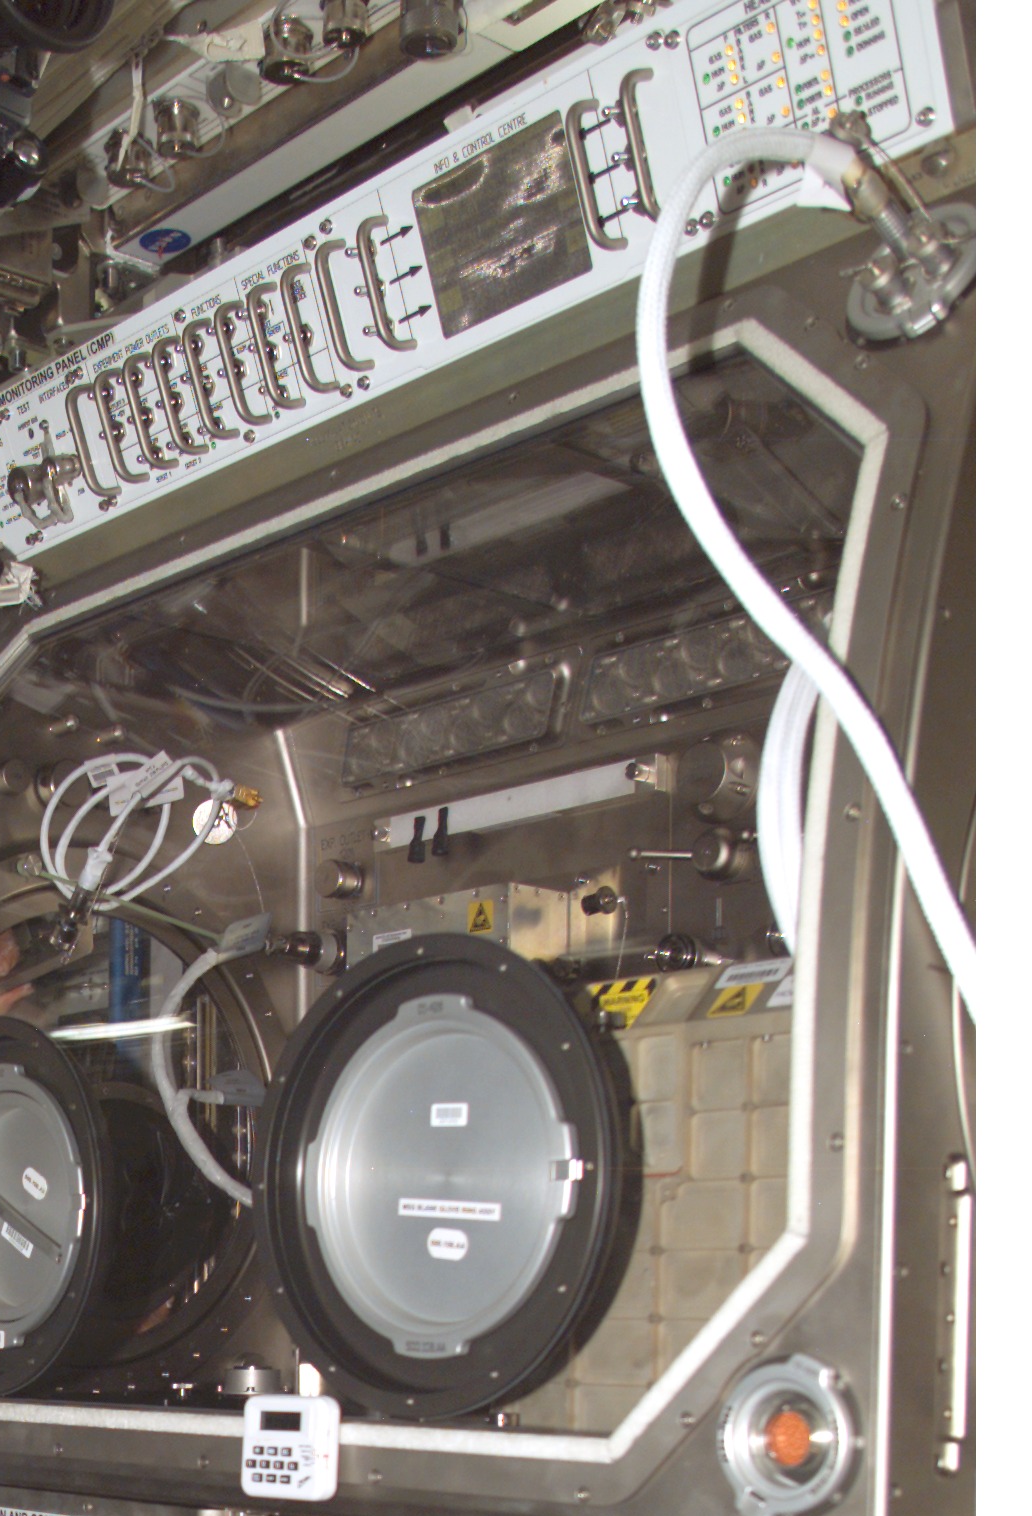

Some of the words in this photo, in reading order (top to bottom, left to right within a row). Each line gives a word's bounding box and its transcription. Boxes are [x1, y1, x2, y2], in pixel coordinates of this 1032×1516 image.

[433, 158, 450, 174] INFO
[453, 152, 460, 162] &
[461, 133, 495, 158] CONTROL
[497, 112, 528, 138] CENTRE
[241, 271, 265, 289] SPECIAL
[267, 250, 300, 276] FUNCTIONS
[191, 295, 222, 317] FUNCTIONS
[145, 324, 170, 345] OUTLETS
[0, 367, 54, 406] MONITORING
[55, 349, 86, 373] PANEL
[86, 331, 114, 357] (CMP)
[17, 402, 30, 415] TEST
